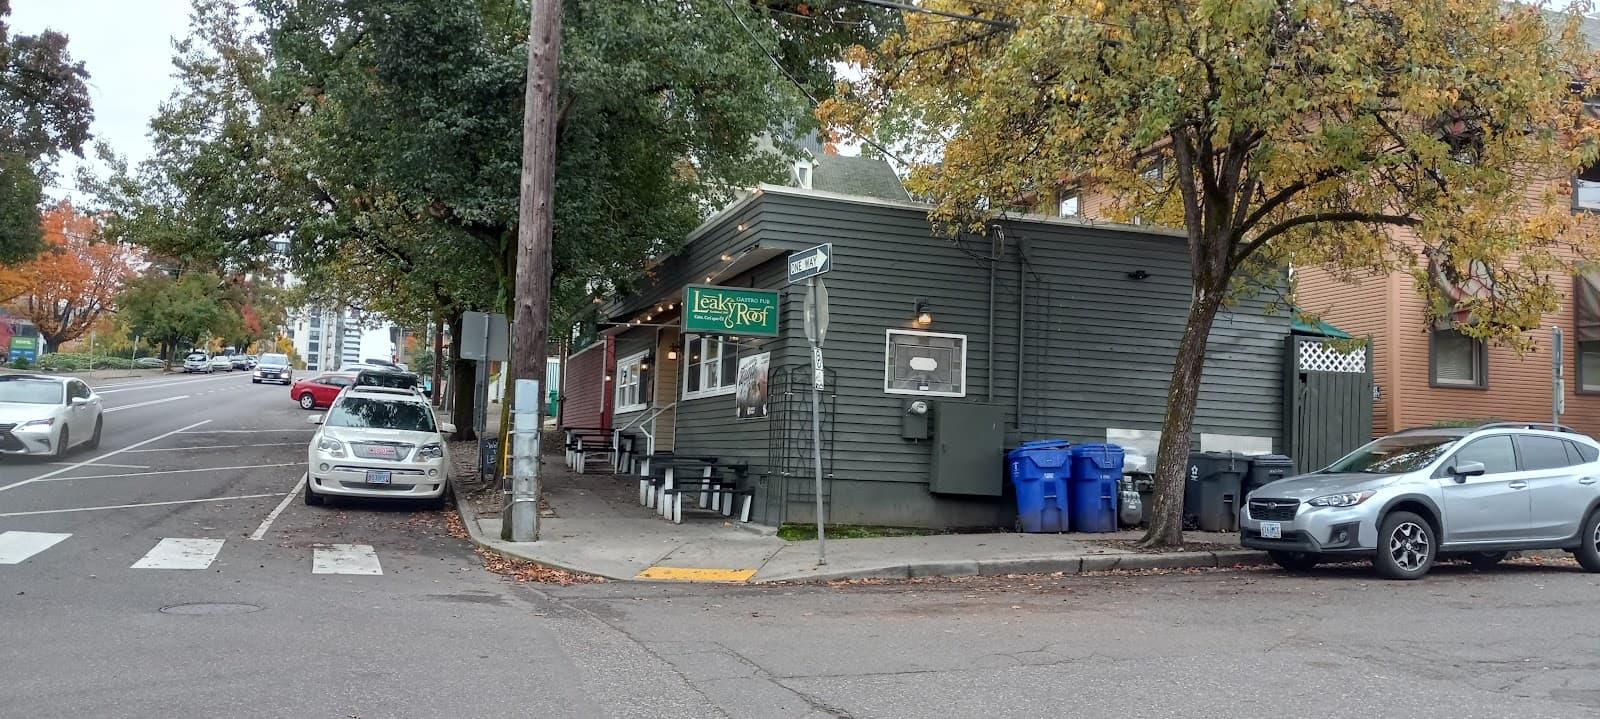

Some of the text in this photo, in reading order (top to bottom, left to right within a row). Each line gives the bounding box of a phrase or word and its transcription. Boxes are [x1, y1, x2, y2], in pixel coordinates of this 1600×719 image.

[791, 255, 818, 274] ONE WAY
[692, 290, 769, 328] Leaky Roof
[736, 296, 759, 304] GASTRO
